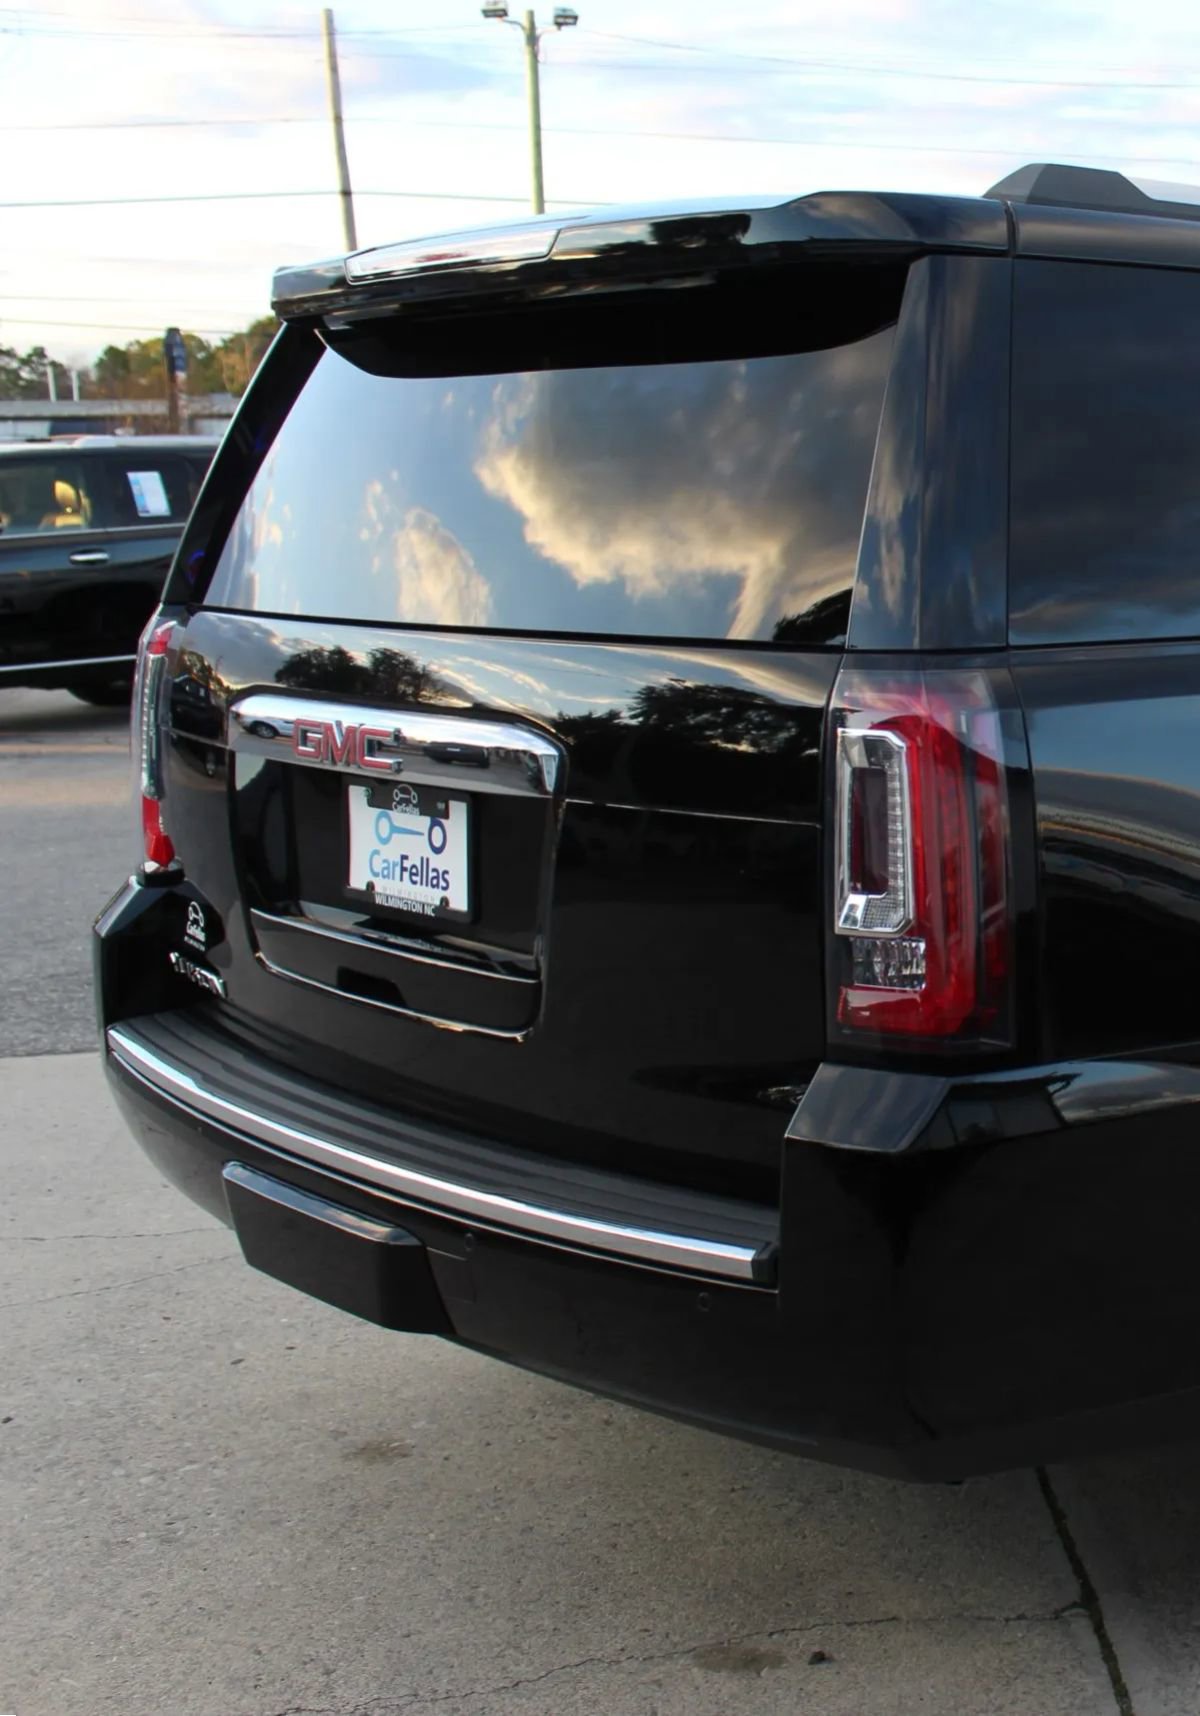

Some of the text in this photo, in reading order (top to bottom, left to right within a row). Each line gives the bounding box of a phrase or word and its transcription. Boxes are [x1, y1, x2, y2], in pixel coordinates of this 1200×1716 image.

[292, 718, 404, 774] GMC
[369, 848, 450, 892] CarFellas
[375, 893, 435, 917] WILMINGTON NC
